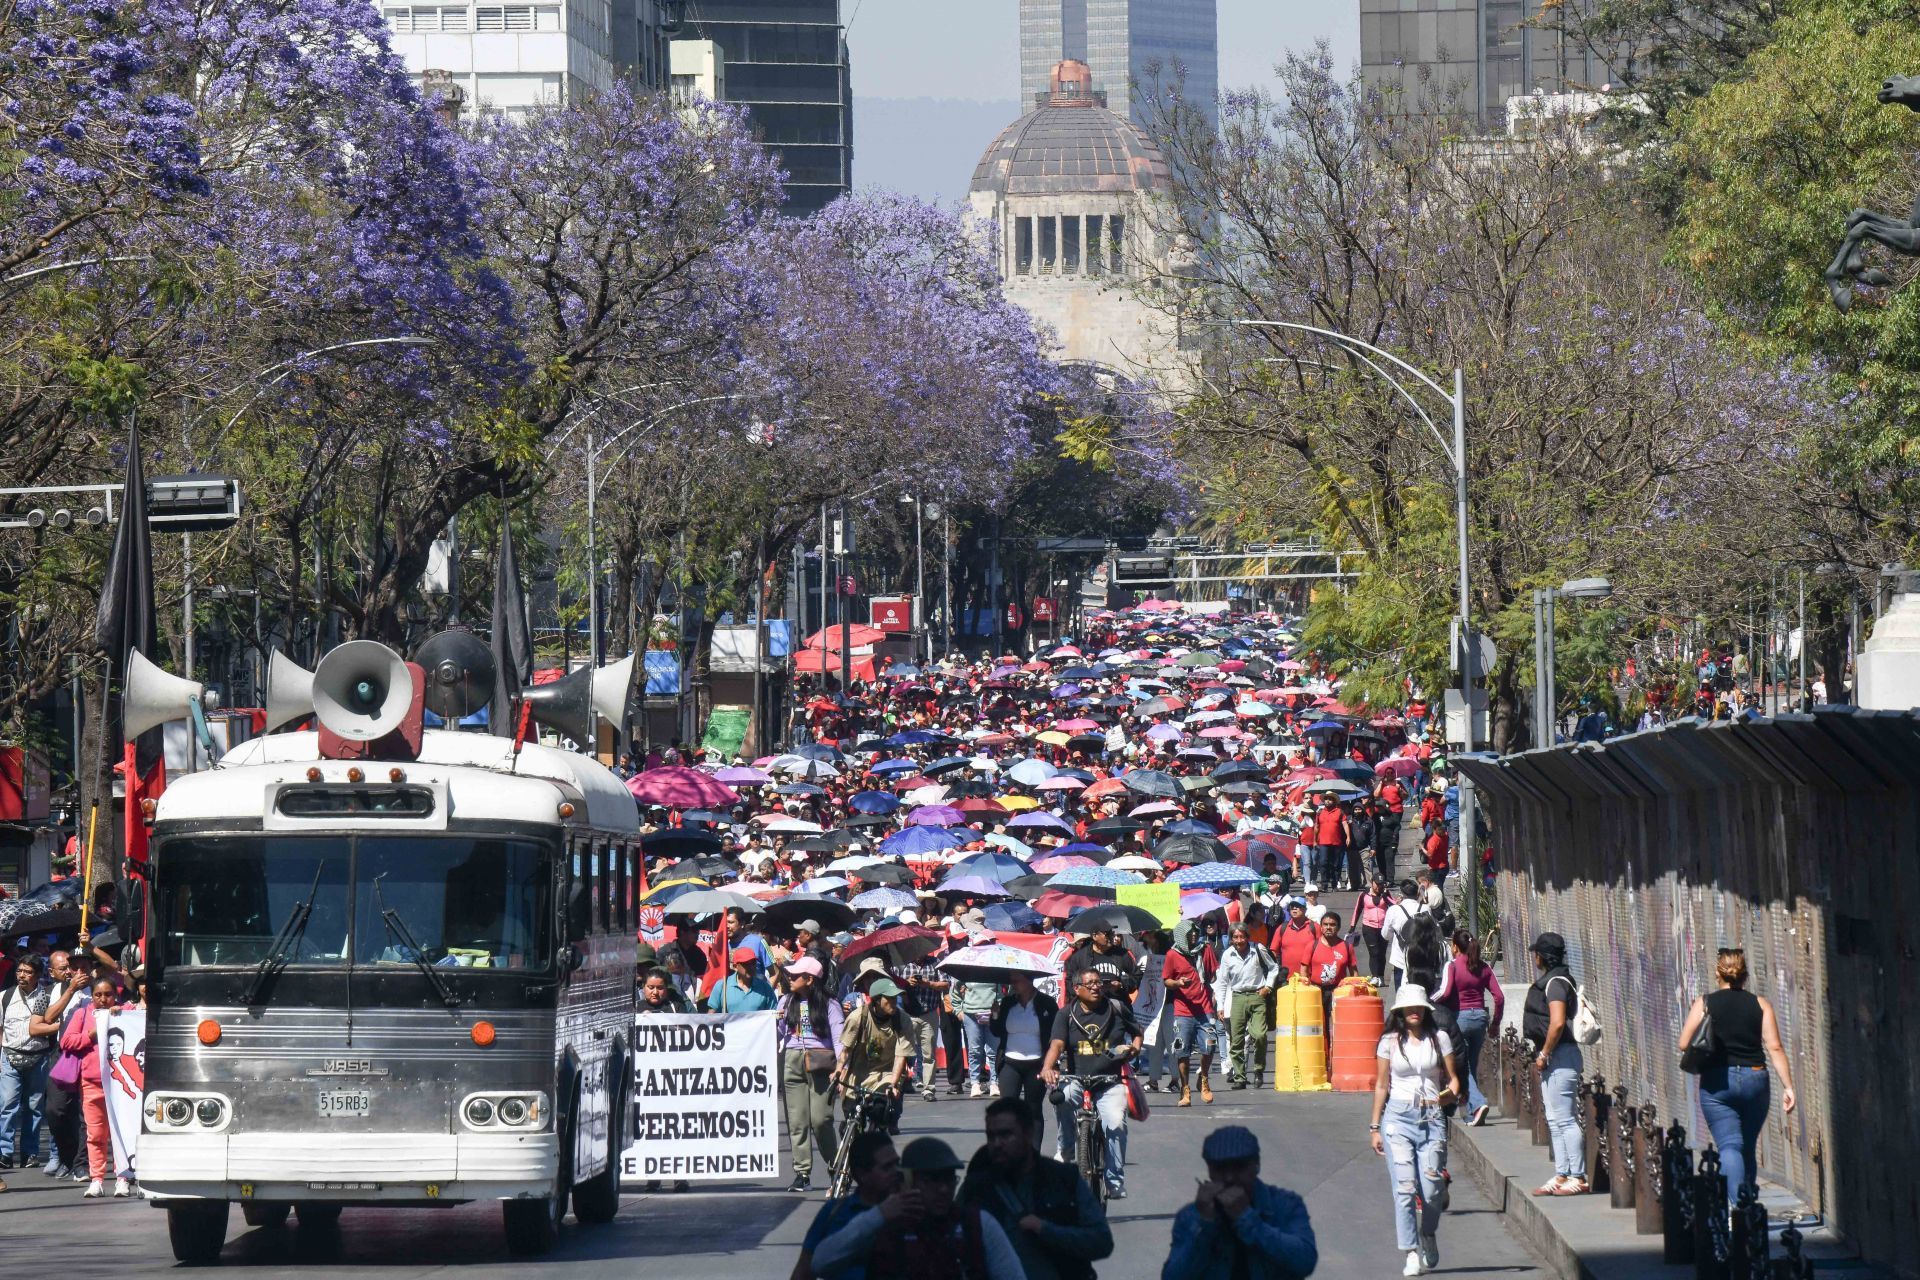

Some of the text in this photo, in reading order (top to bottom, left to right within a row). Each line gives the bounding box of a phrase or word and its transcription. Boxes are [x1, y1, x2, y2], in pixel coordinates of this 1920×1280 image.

[635, 1023, 726, 1052] UNIDOS
[324, 1059, 370, 1071] MASA
[321, 1096, 368, 1110] 515RB3
[619, 1153, 774, 1175] E DEFIENDEN!!
